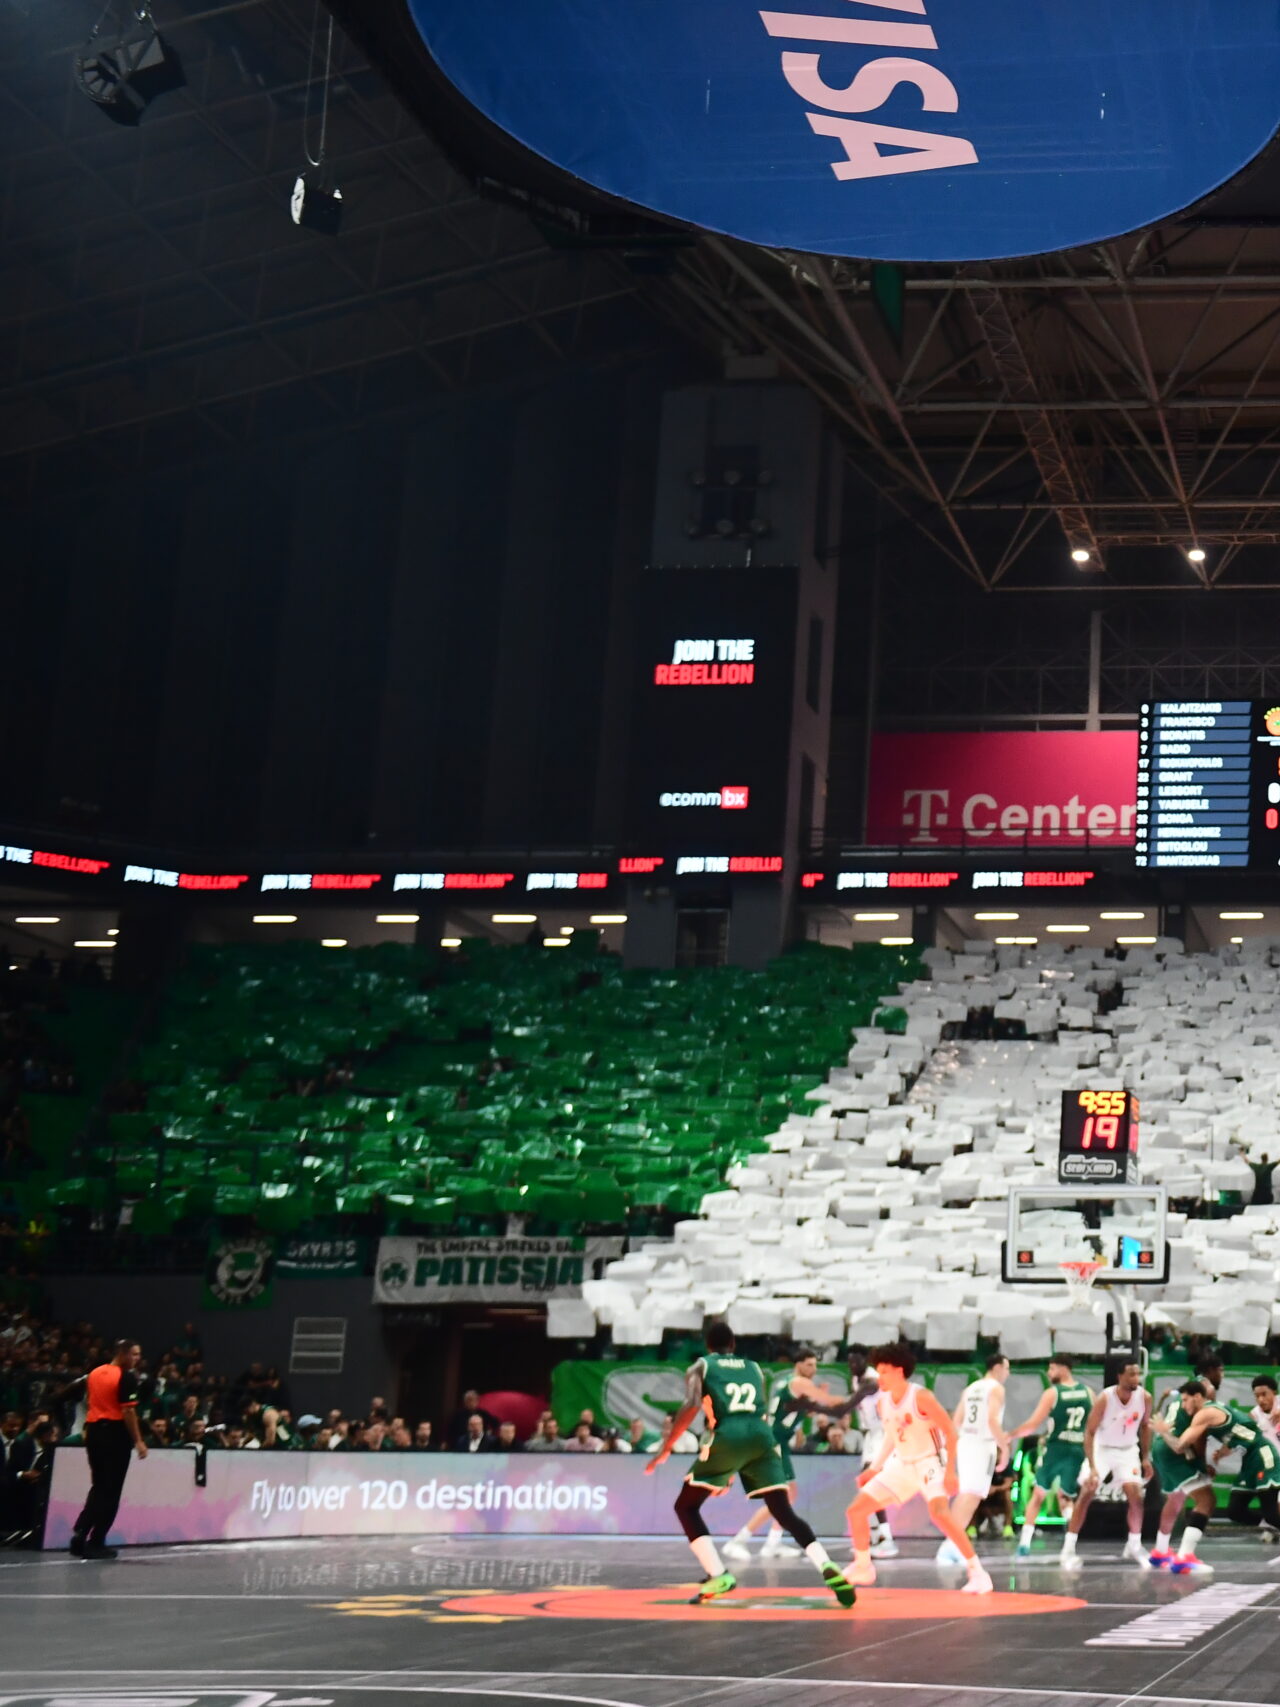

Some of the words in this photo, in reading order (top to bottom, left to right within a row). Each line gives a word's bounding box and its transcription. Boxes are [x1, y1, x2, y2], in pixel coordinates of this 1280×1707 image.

[672, 640, 715, 664] JOIN
[717, 639, 755, 661] THE
[655, 664, 754, 685] REBELLION
[1141, 718, 1149, 727] 3
[1140, 745, 1148, 754] 7
[1268, 782, 1280, 803] 0
[963, 794, 1138, 837] Center
[1265, 808, 1278, 829] 0
[1079, 1091, 1126, 1116] 9:55
[1082, 1117, 1119, 1149] 19
[414, 1256, 584, 1286] PATISSIA
[725, 1383, 757, 1412] 22
[968, 1405, 978, 1423] 3
[251, 1479, 275, 1519] Fly
[278, 1483, 295, 1511] to
[296, 1485, 350, 1511] over
[360, 1480, 408, 1510] 120
[416, 1479, 608, 1512] destinations
